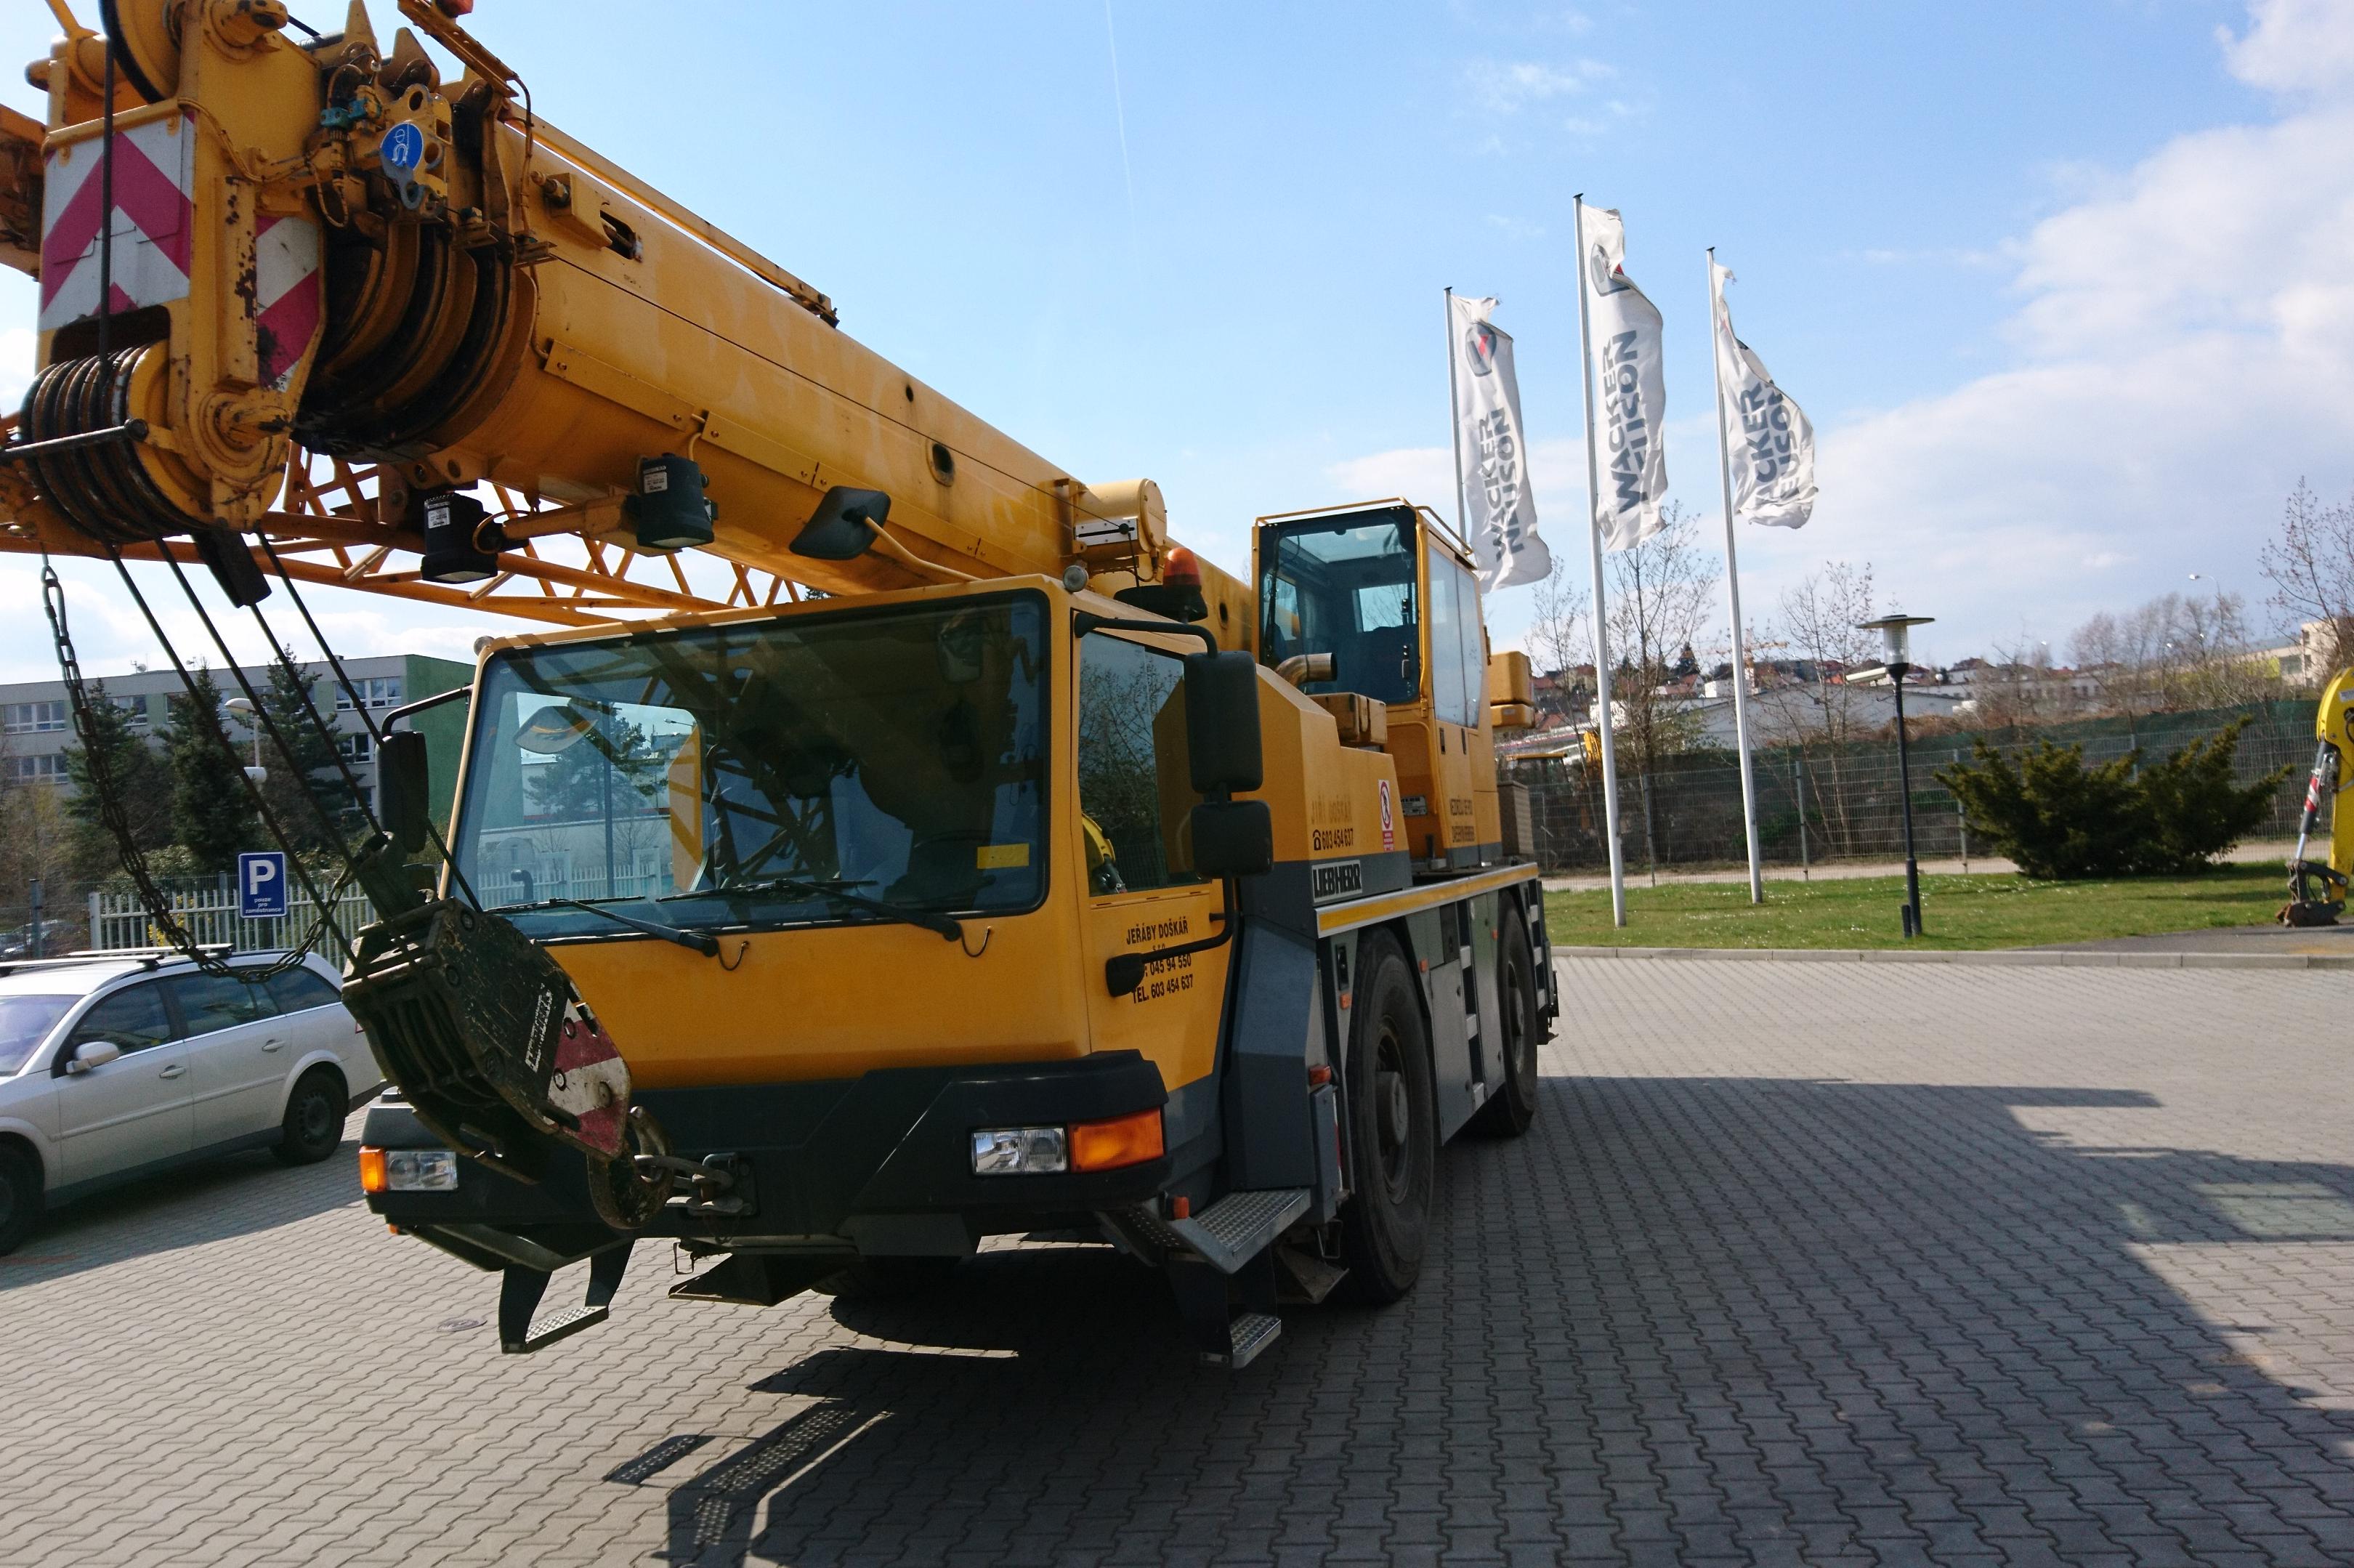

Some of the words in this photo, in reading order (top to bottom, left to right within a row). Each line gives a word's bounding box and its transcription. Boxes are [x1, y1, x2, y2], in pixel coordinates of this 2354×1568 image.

[1602, 338, 1641, 514] WACKER
[1479, 412, 1507, 562] WACKER
[1322, 830, 1333, 849] 603
[1334, 828, 1343, 847] 454
[1344, 828, 1354, 846] 637
[248, 860, 275, 895] P
[1312, 863, 1362, 899] LIEBHERR
[1126, 922, 1156, 945] JEŘÁBY
[1158, 916, 1189, 939] DOŠKÁŘ
[1149, 960, 1165, 976] 045
[1167, 958, 1176, 971] 94
[1178, 953, 1192, 969] 550
[1132, 986, 1149, 1003] TEL.
[1151, 981, 1165, 998] 603
[1167, 977, 1180, 993] 454
[1181, 974, 1194, 990] 637
